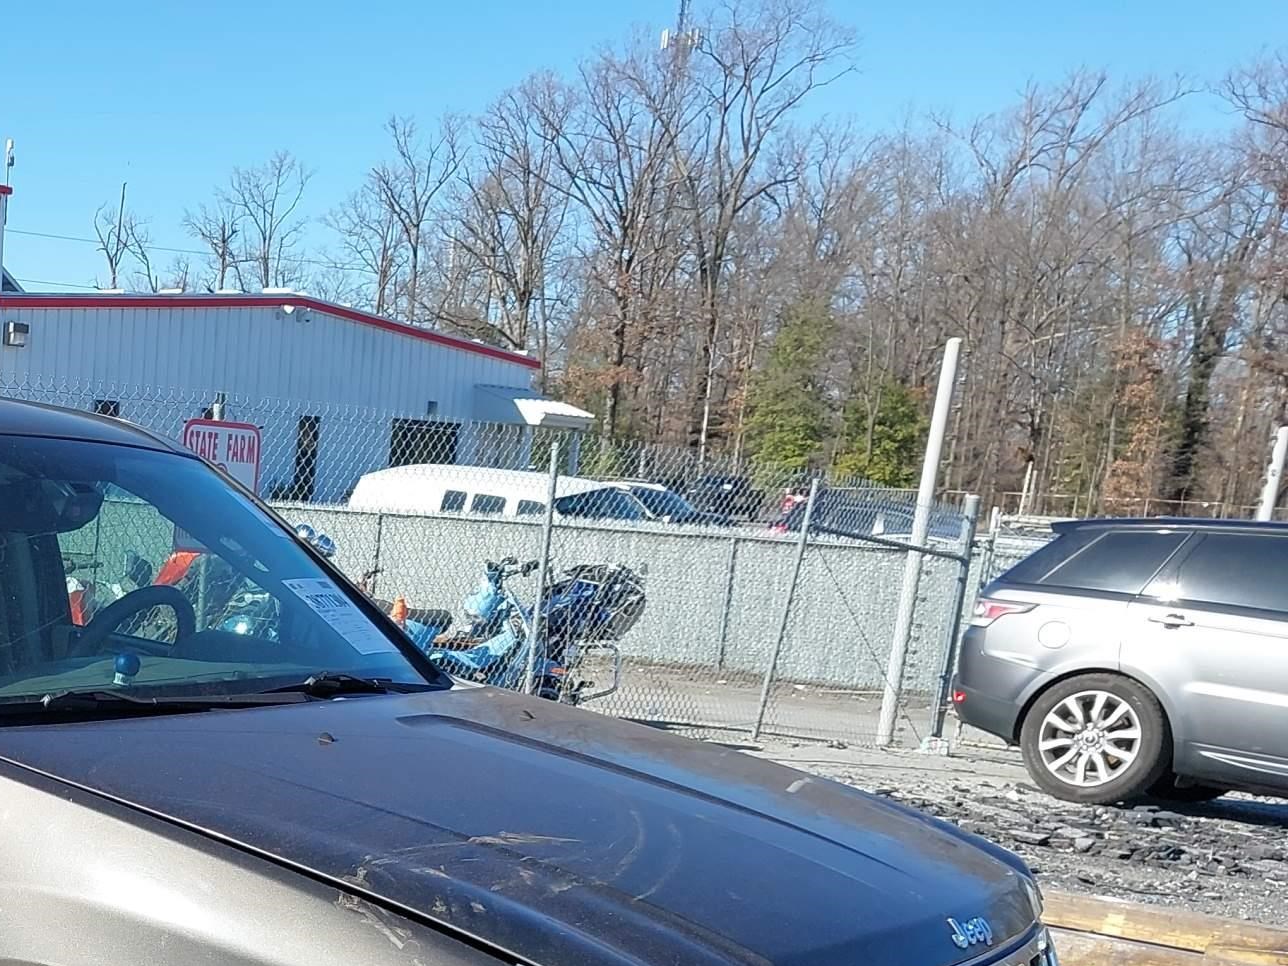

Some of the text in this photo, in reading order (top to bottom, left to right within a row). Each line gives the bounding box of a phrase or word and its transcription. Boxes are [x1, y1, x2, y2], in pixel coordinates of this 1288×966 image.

[189, 430, 256, 464] STATE FARM
[946, 917, 993, 949] Jeep
